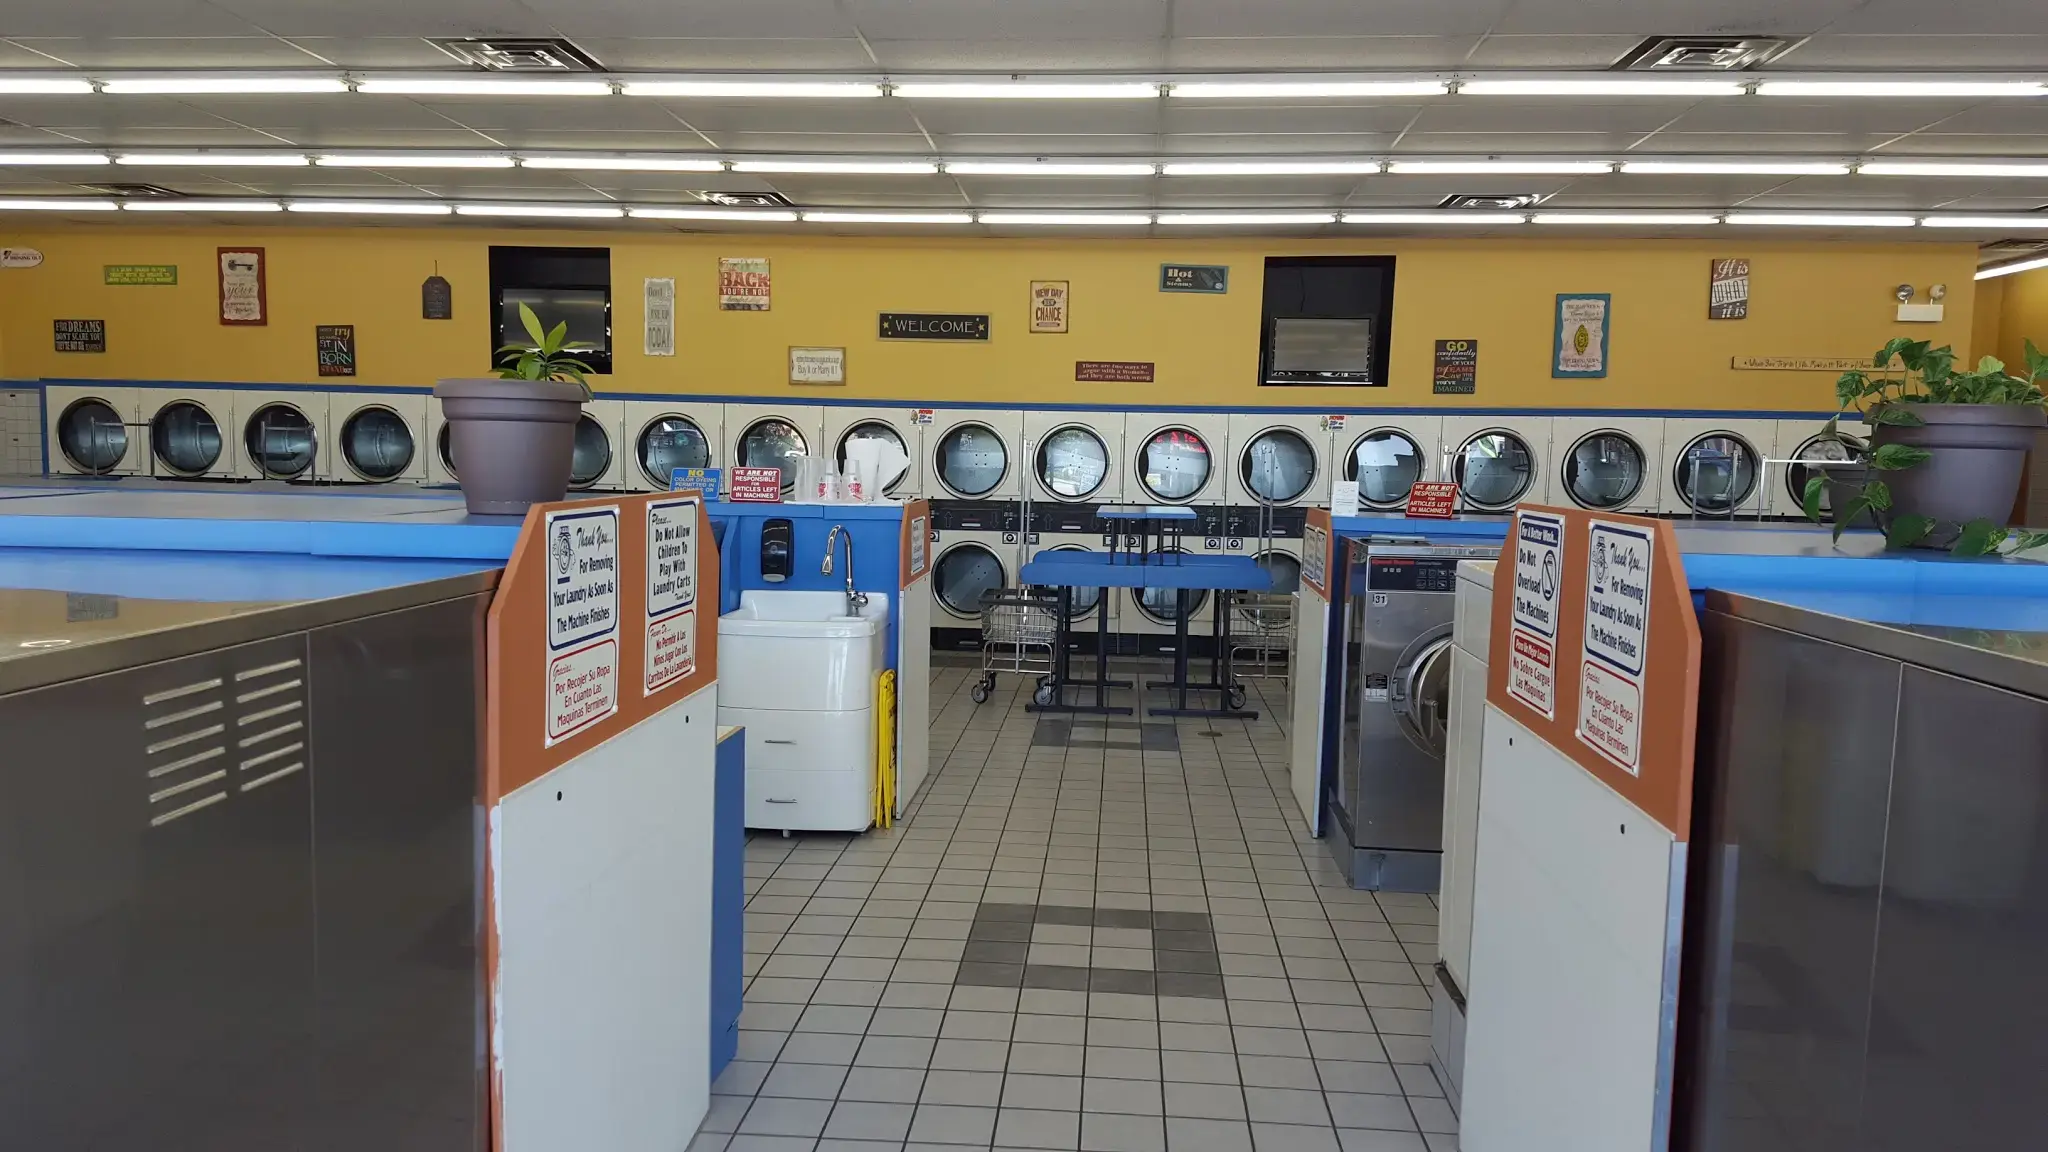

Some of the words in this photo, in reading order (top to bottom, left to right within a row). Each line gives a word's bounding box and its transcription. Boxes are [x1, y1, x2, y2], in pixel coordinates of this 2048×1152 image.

[720, 271, 770, 287] BACK
[1167, 268, 1193, 278] Hot
[1713, 258, 1736, 280] It
[1737, 261, 1749, 275] is
[722, 287, 748, 296] YOU'RE
[752, 288, 768, 296] NOT
[1035, 288, 1050, 299] NEW
[1050, 288, 1064, 298] DAY
[1713, 279, 1748, 303] WHAT
[1036, 306, 1062, 322] CHANCE
[1722, 304, 1733, 318] it
[1734, 302, 1746, 316] is
[68, 321, 101, 332] DREAMS
[334, 328, 350, 340] try
[896, 319, 975, 333] WELCOME
[334, 340, 347, 352] IN
[648, 327, 672, 348] TODAY
[1446, 341, 1468, 351] GO
[320, 352, 352, 365] BORN
[1436, 349, 1476, 358] confidently
[688, 470, 704, 478] NO
[576, 527, 595, 549] Thank
[656, 529, 662, 542] Do
[664, 527, 674, 540] Not
[675, 525, 690, 539] Allow
[658, 544, 680, 560] Children
[682, 541, 688, 554] To
[1520, 548, 1526, 564] Do
[1527, 549, 1536, 567] Not
[1610, 542, 1628, 567] Thank
[580, 559, 588, 574] For
[589, 554, 613, 572] Removing
[660, 562, 671, 578] Play
[672, 559, 686, 573] With
[553, 591, 566, 607] Your
[566, 586, 586, 604] Laundry
[588, 584, 594, 598] As
[594, 582, 606, 597] Soon
[607, 579, 614, 594] As
[654, 579, 675, 596] Laundry
[677, 575, 690, 589] Carts
[1518, 572, 1541, 594] Overload
[1612, 576, 1620, 593] For
[1620, 578, 1644, 605] Removing
[1375, 595, 1386, 604] 31
[1516, 596, 1525, 614] The
[1526, 600, 1548, 624] Machines
[557, 618, 567, 634] The
[568, 611, 589, 630] Machine
[590, 606, 610, 624] Finishes
[1590, 596, 1599, 614] Your
[1600, 599, 1617, 624] Laundry
[1617, 606, 1624, 623] As
[1624, 608, 1634, 628] Soon
[1635, 613, 1642, 631] As
[1599, 627, 1617, 650] Machine
[1618, 635, 1636, 658] Finishes
[556, 683, 566, 696] Por
[567, 673, 587, 690] Recojer
[589, 670, 596, 681] Su
[596, 666, 610, 678] Ropa
[648, 670, 664, 685] Carritos
[664, 666, 670, 678] De
[670, 663, 674, 675] La
[1513, 656, 1520, 670] No
[1520, 660, 1533, 677] Sobre
[1534, 667, 1550, 687] Cargue
[565, 696, 572, 708] En
[573, 688, 592, 704] Cuanto
[593, 684, 602, 694] Las
[1524, 679, 1546, 703] Maquinas
[558, 707, 584, 728] Maquinas
[585, 696, 608, 714] Terminen
[1586, 686, 1594, 700] Por
[1594, 690, 1612, 710] Recojer
[1612, 700, 1619, 714] Su
[1620, 704, 1633, 723] Ropa
[1592, 705, 1598, 719] En
[1598, 709, 1614, 730] Cuanto
[1615, 718, 1624, 735] Las
[1586, 718, 1606, 742] Maquinas
[1606, 731, 1628, 756] Terminen
